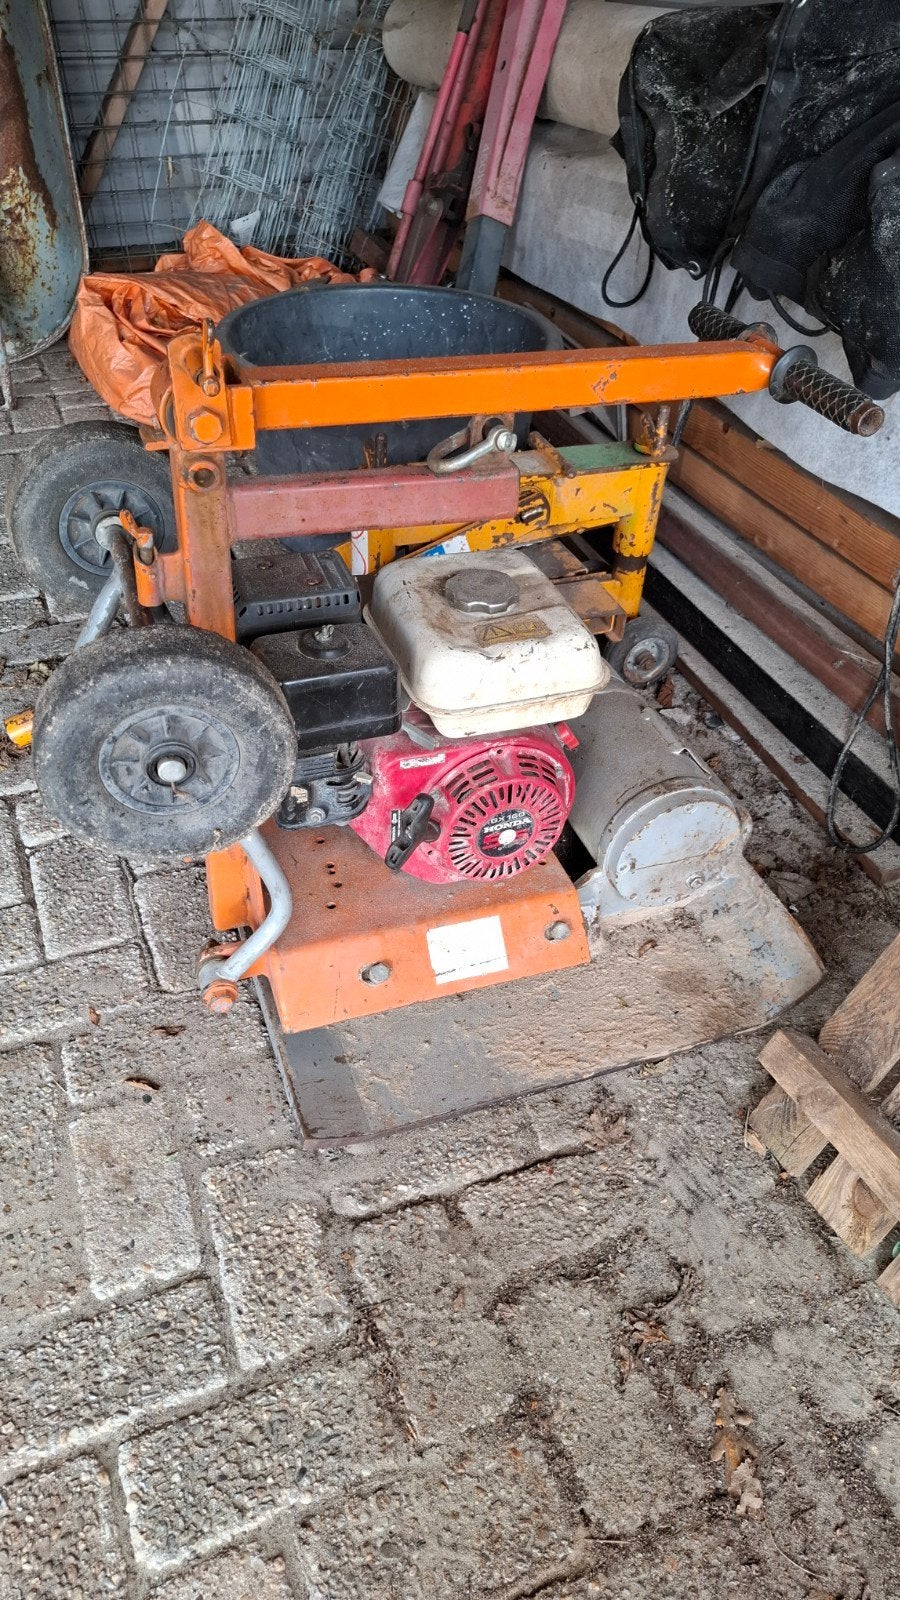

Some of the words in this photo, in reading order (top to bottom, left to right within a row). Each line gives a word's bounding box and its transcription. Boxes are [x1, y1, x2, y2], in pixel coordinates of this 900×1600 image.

[491, 816, 505, 824] GX
[507, 812, 525, 821] 160
[484, 818, 532, 833] HONDA
